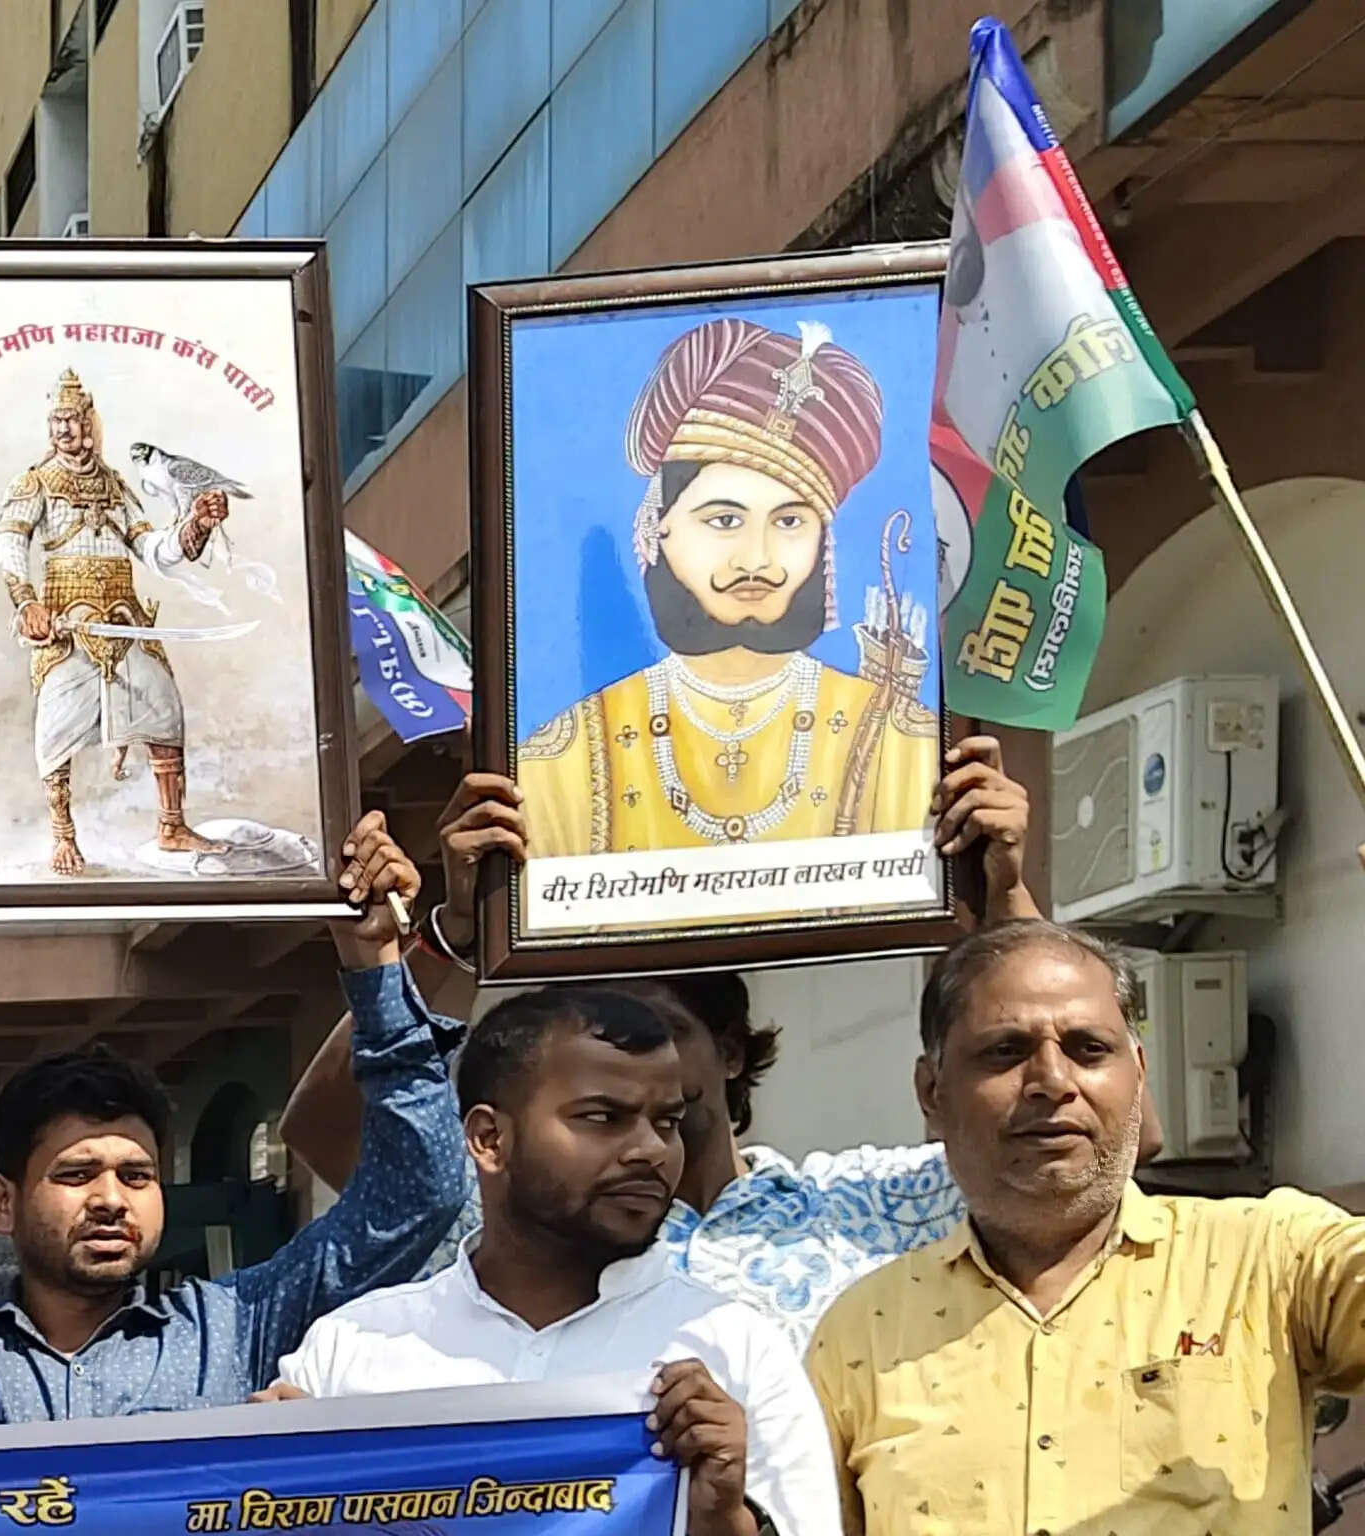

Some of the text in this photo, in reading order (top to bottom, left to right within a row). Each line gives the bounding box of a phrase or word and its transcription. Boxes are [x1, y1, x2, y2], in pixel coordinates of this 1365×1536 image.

[62, 323, 166, 349] महाराजा
[172, 337, 219, 369] कंस
[222, 362, 276, 412] पासी
[541, 850, 926, 902] वीर शिरोमणि महाराजा लाखन पासी
[0, 1477, 79, 1526] रहें
[186, 1477, 617, 1533] मा. चिराग पासवान जिन्दाबाद
